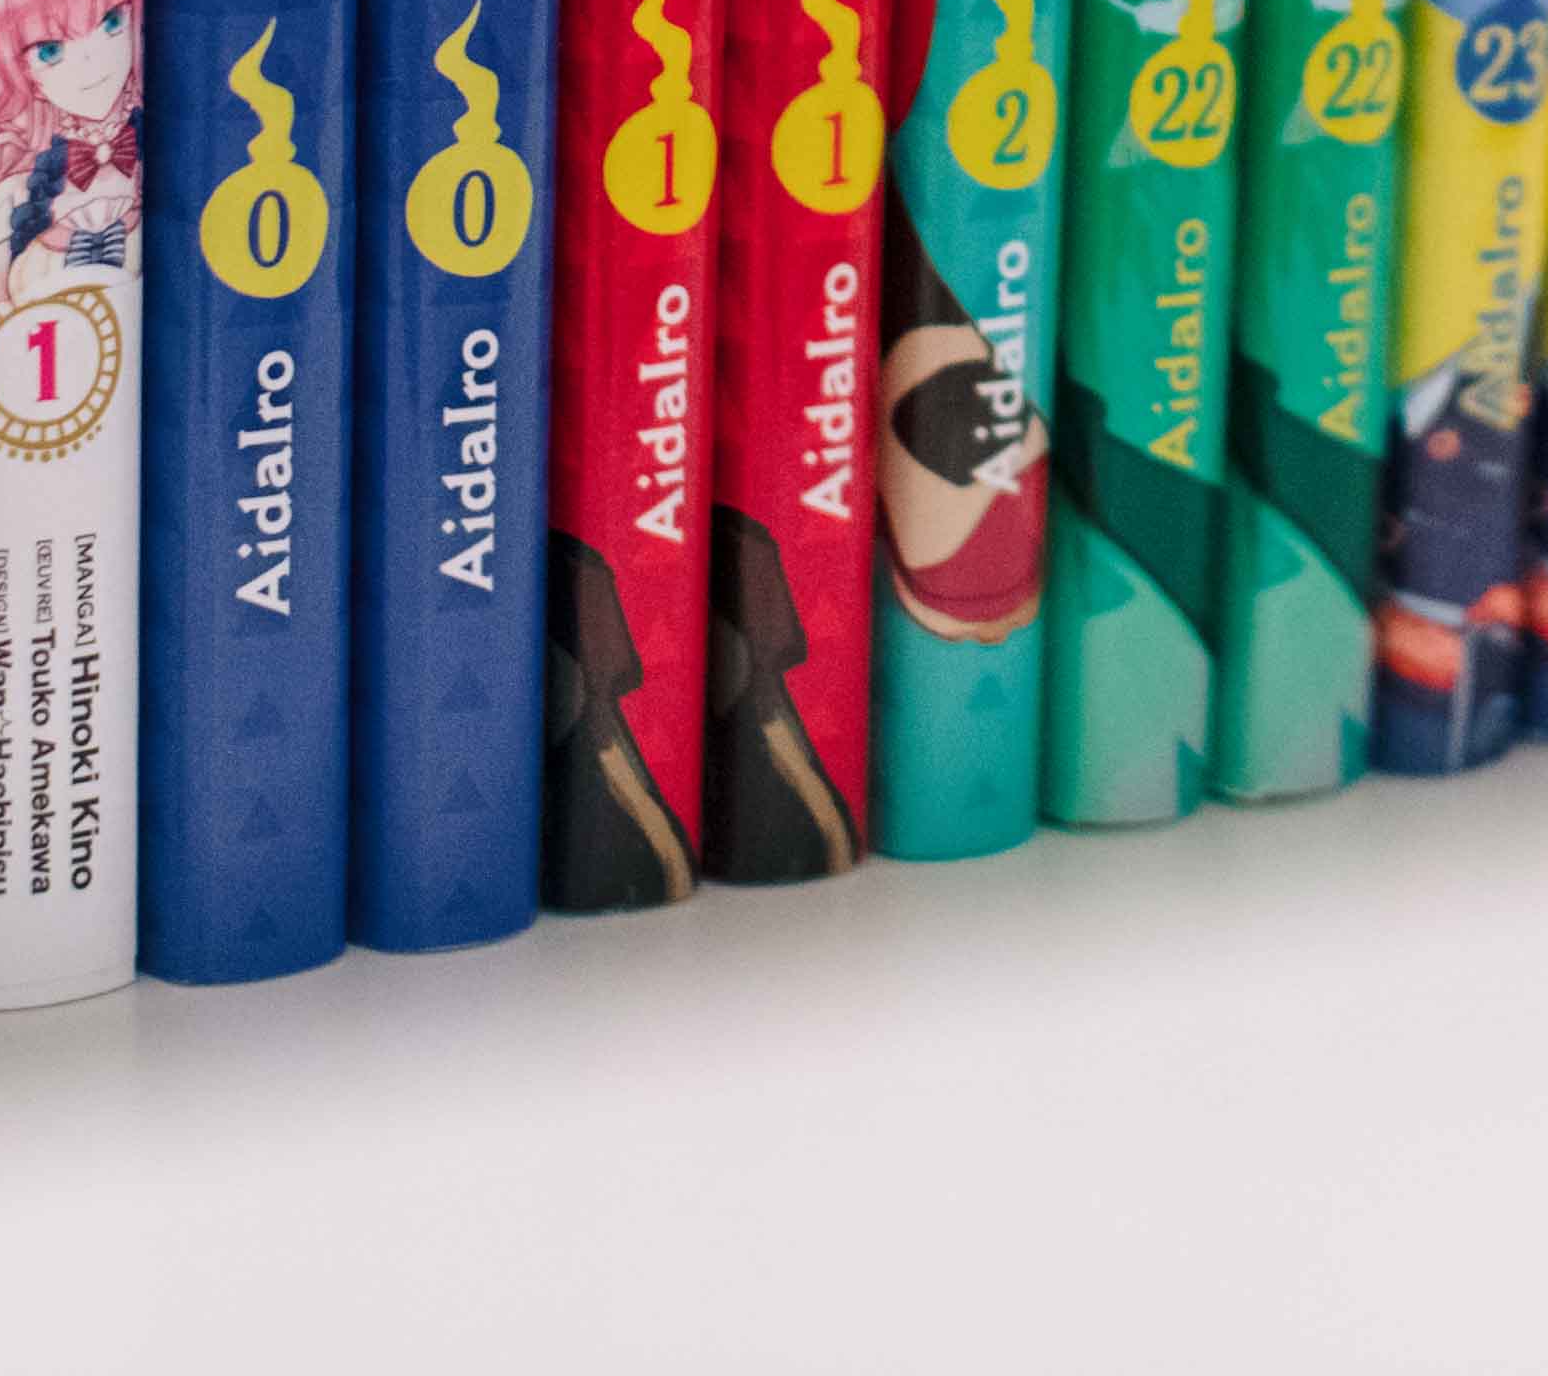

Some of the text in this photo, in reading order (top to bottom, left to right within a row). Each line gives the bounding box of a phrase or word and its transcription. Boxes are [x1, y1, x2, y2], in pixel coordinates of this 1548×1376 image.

[1150, 62, 1226, 143] 22
[1320, 40, 1394, 119] 22
[820, 112, 848, 187] 1
[992, 89, 1030, 166] 2
[453, 170, 496, 248] 0
[653, 131, 679, 208] 1
[248, 190, 290, 268] 0
[27, 319, 60, 404] 1
[30, 628, 58, 729] Touko
[70, 651, 101, 786] Hinoki
[29, 736, 57, 897] Amekawa
[69, 794, 101, 894] Kino
